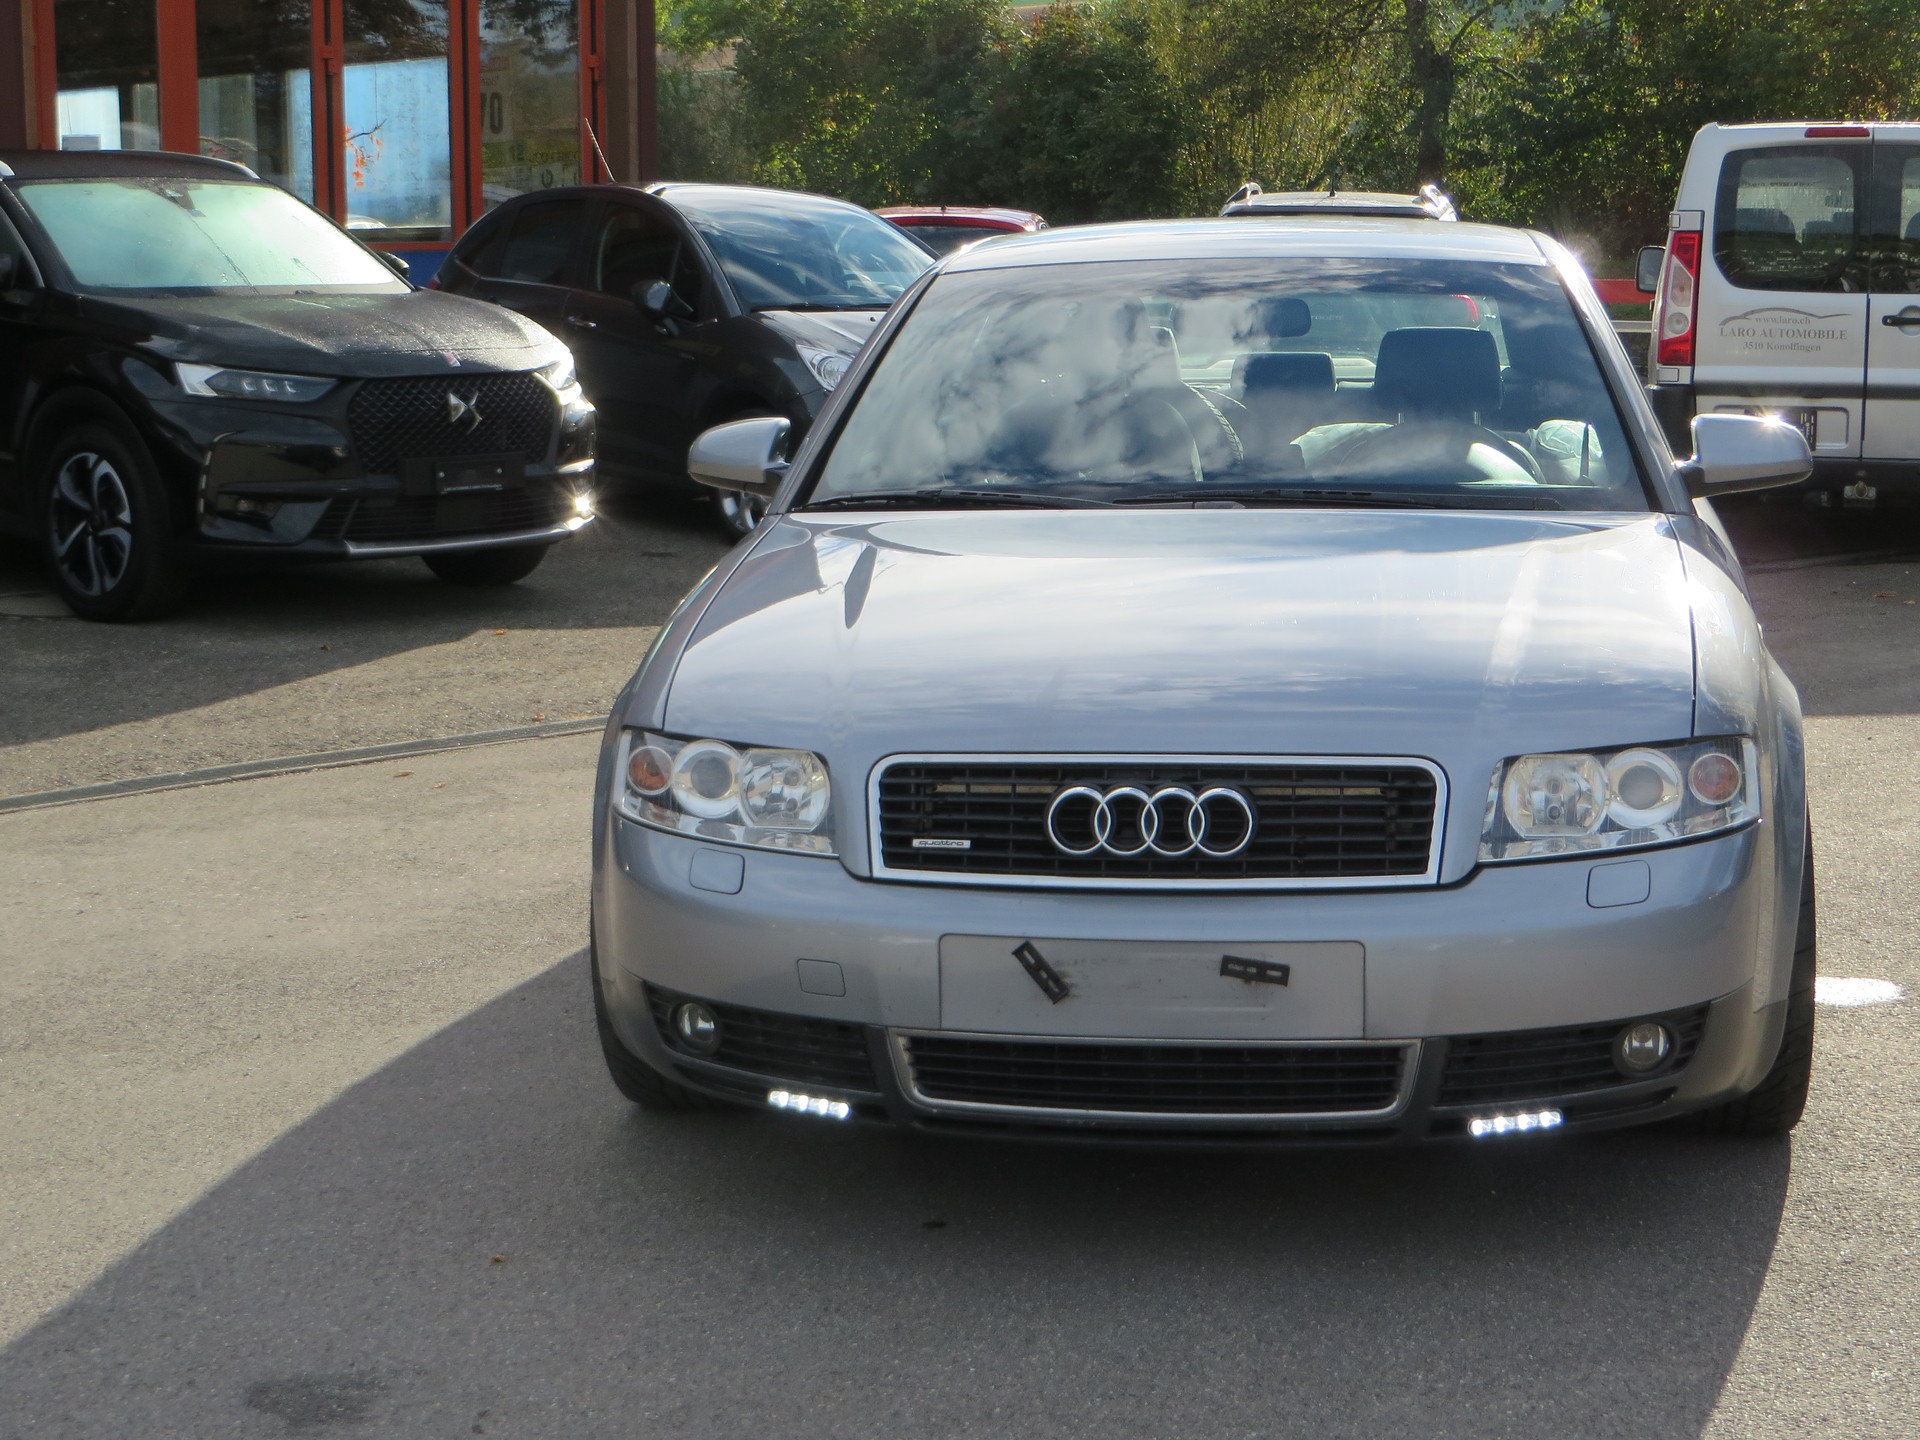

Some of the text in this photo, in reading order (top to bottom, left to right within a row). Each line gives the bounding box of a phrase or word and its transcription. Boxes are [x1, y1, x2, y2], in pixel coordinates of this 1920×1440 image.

[1755, 315, 1811, 325] www.laro.ch
[1719, 327, 1848, 340] LARO AUTOMOBILE
[1743, 341, 1821, 352] 3510 Konolfingen
[919, 840, 964, 848] quattro
